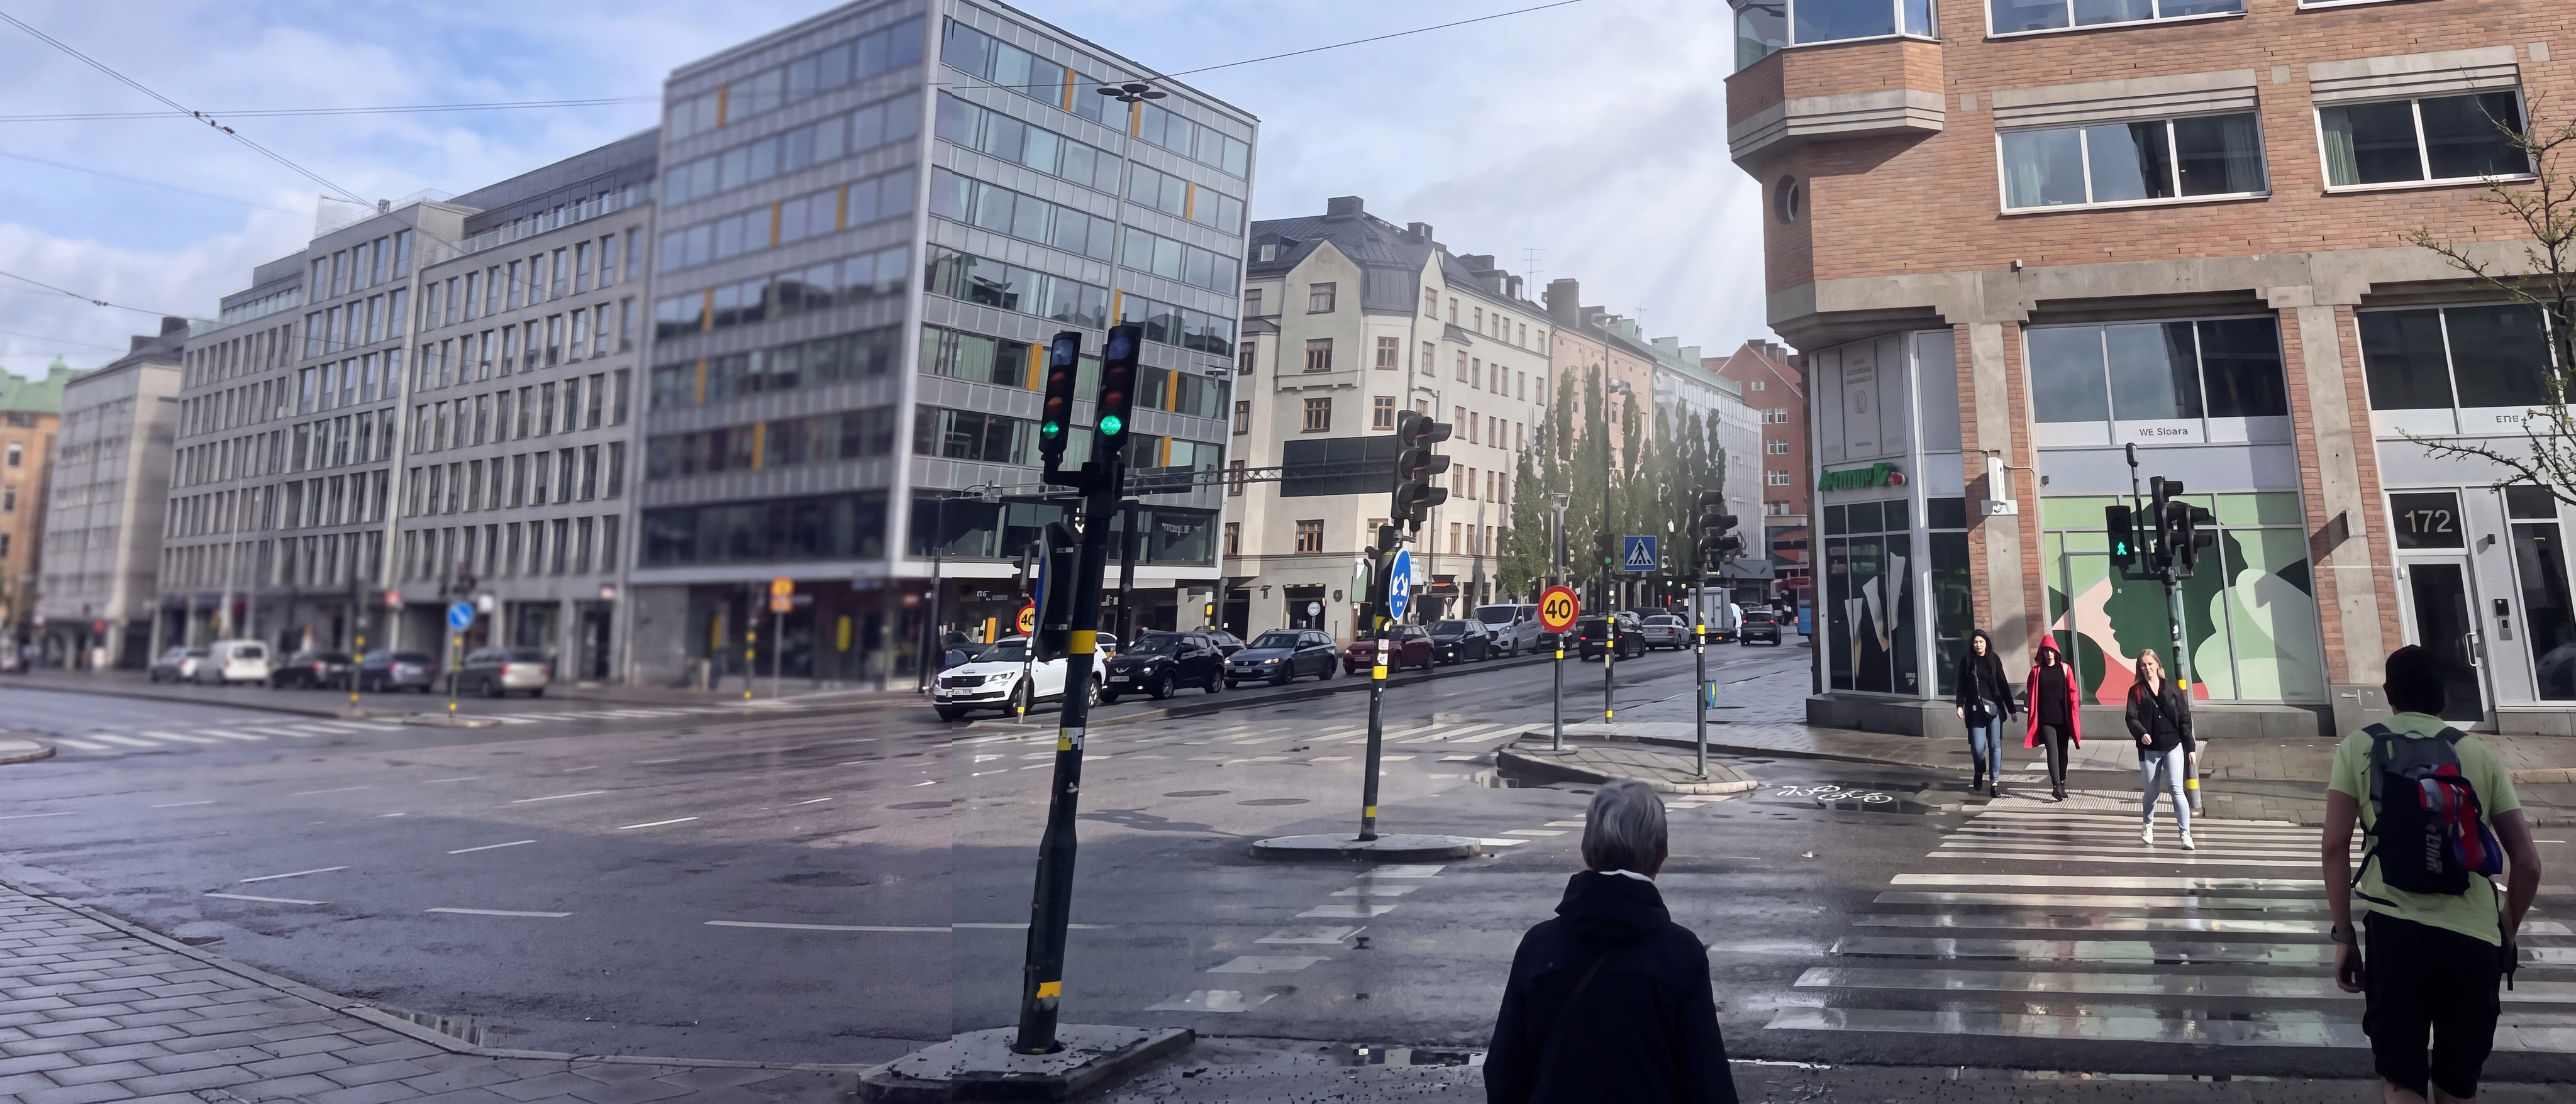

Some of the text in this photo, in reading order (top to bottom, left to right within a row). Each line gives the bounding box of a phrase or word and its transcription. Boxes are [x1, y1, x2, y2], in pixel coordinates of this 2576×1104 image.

[2139, 428, 2154, 436] WE
[2404, 509, 2453, 533] 172
[1545, 599, 1571, 619] 40
[1020, 613, 1035, 626] 40
